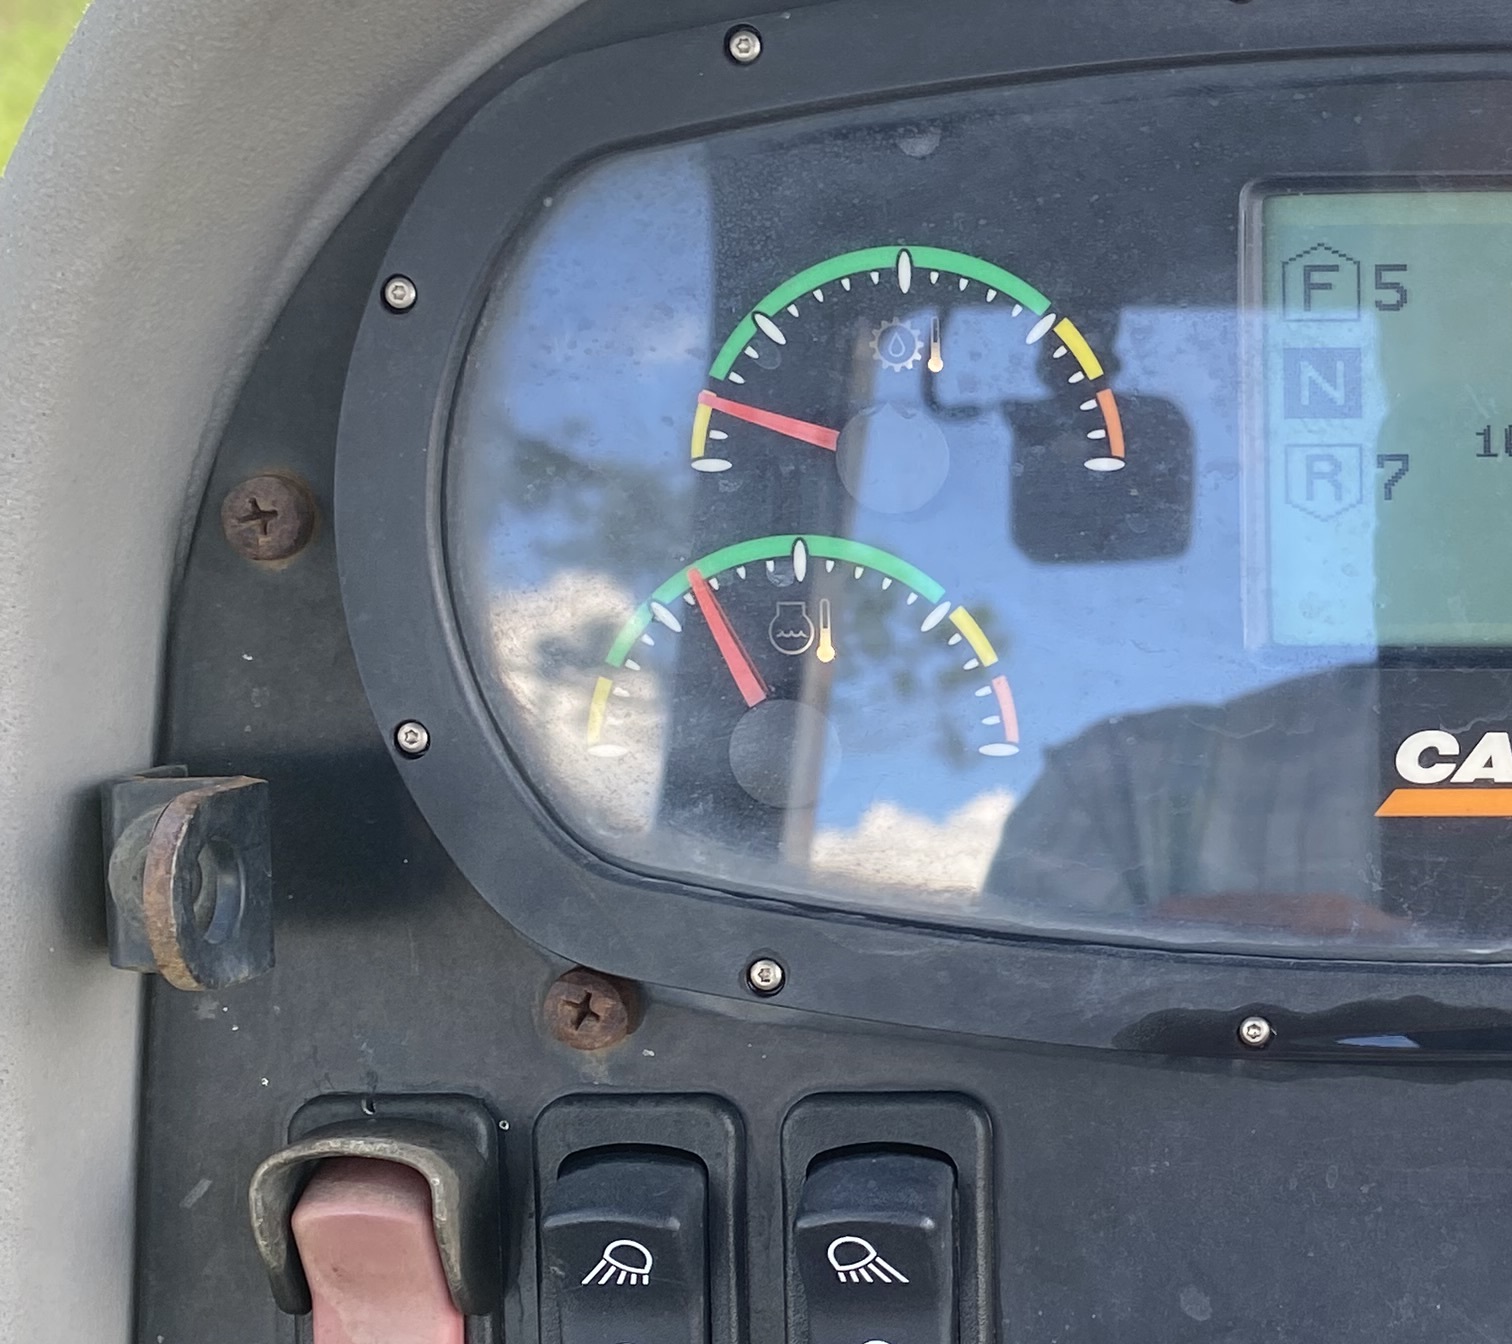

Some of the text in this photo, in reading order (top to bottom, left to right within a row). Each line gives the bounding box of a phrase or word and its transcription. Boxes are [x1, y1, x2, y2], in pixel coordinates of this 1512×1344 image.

[1303, 263, 1408, 312] F 5
[1300, 359, 1345, 407] N
[1305, 453, 1409, 502] R 7
